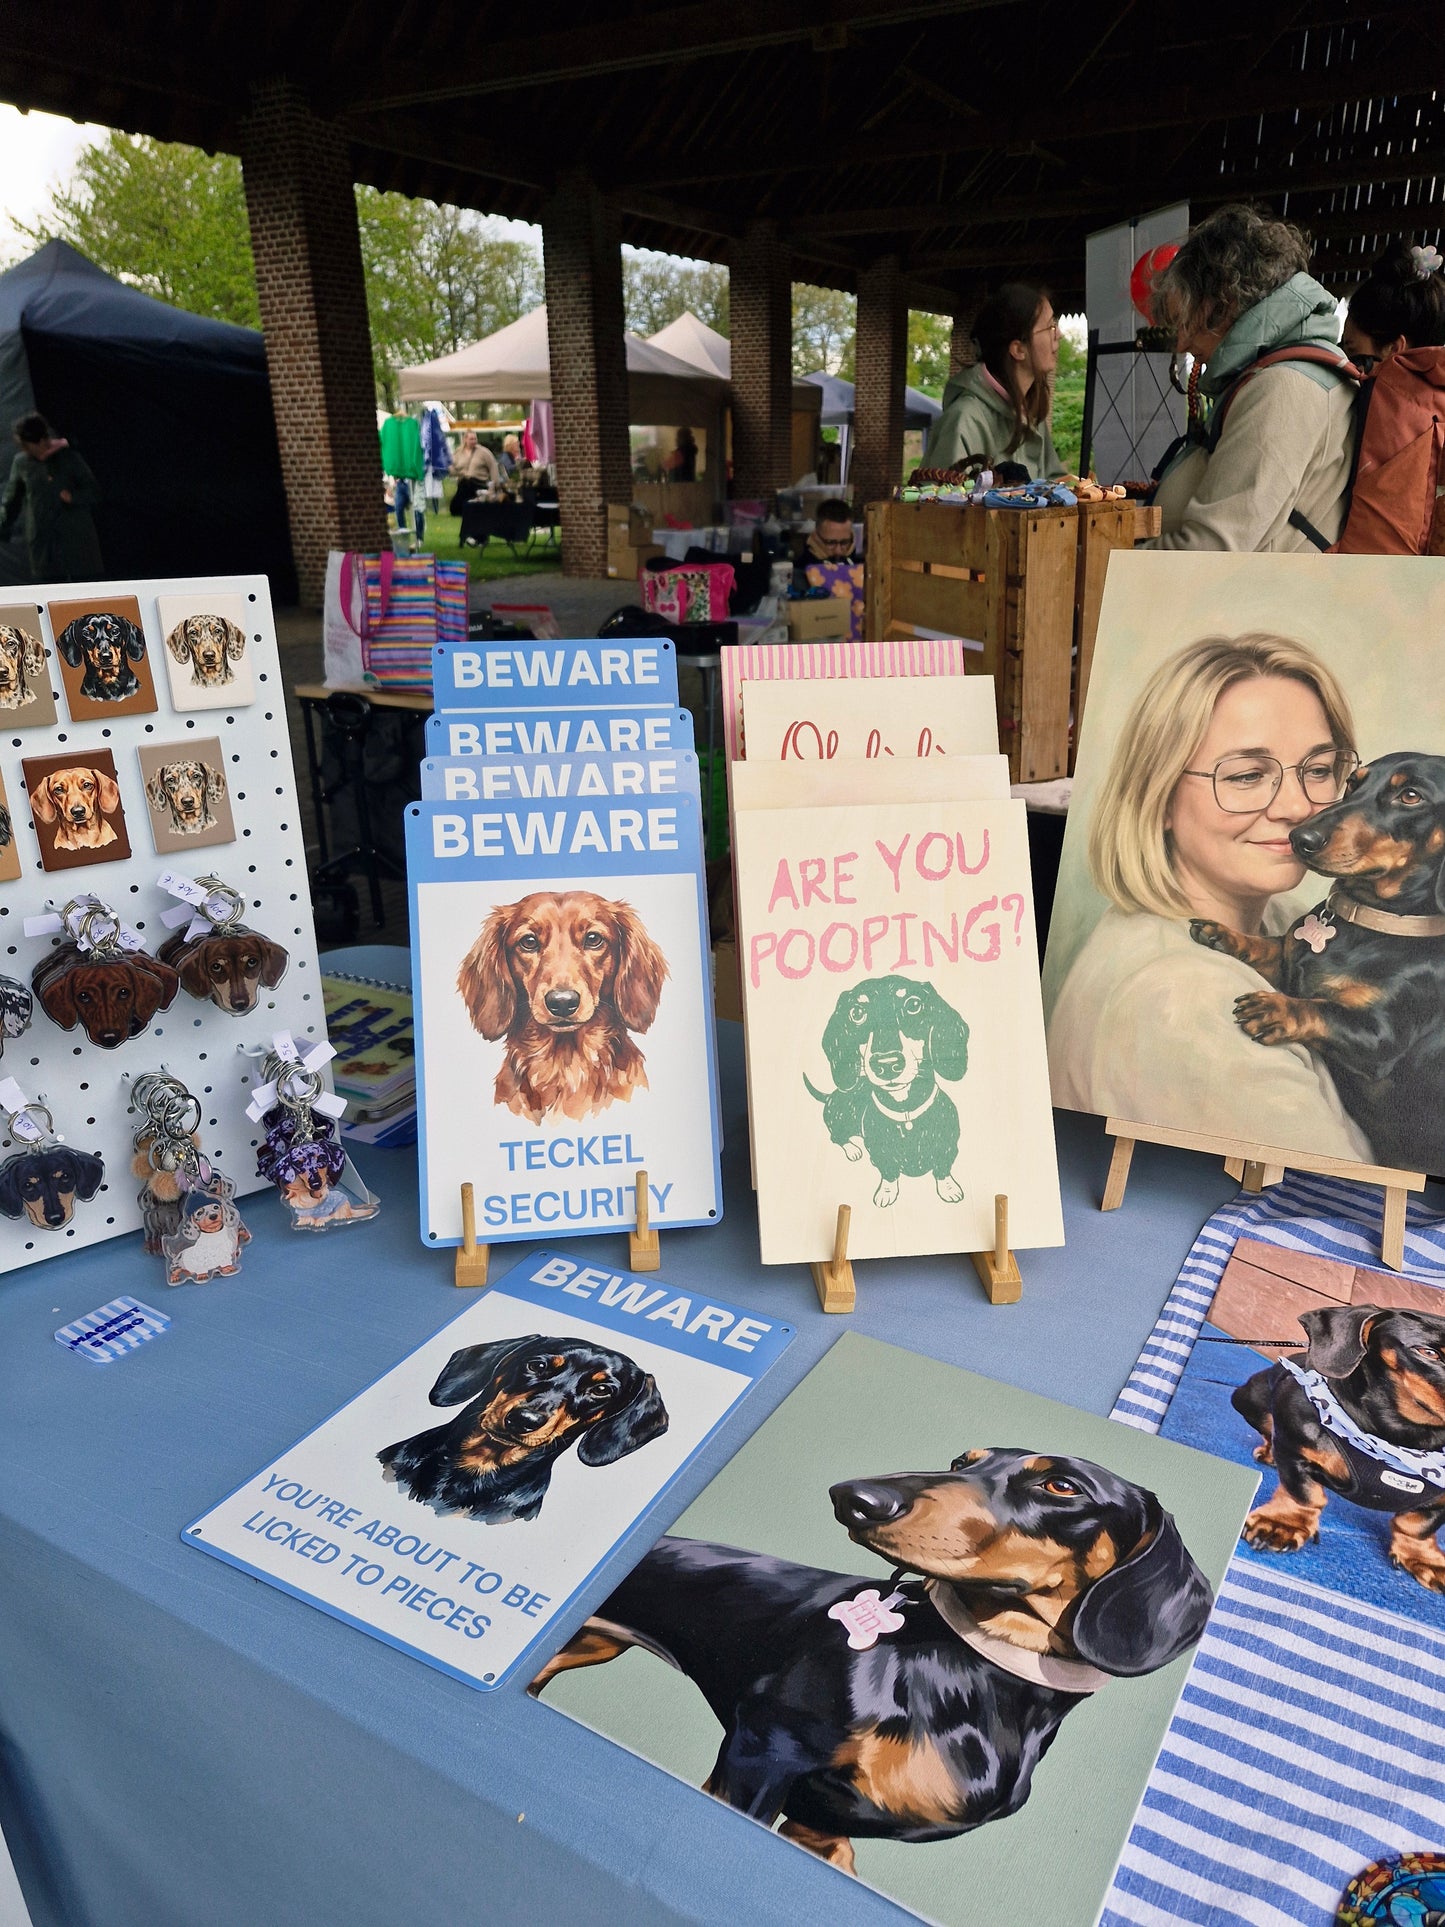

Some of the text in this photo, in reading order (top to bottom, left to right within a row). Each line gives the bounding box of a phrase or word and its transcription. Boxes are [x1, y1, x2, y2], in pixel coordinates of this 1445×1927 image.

[452, 648, 660, 689] BEWARE
[448, 717, 672, 756] BEWARE
[444, 760, 678, 801] BEWARE
[432, 807, 680, 859] BEWARE
[768, 829, 990, 913] ARE YOU
[750, 893, 1025, 990] POOPING?
[499, 1133, 645, 1172] TECKEL
[102, 1317, 145, 1342] EURO
[529, 1257, 772, 1353] BEWARE
[242, 1510, 493, 1640] LICKED TO PIECES
[353, 1518, 461, 1573] ABOUT
[458, 1561, 503, 1595] TO
[501, 1583, 552, 1618] BE
